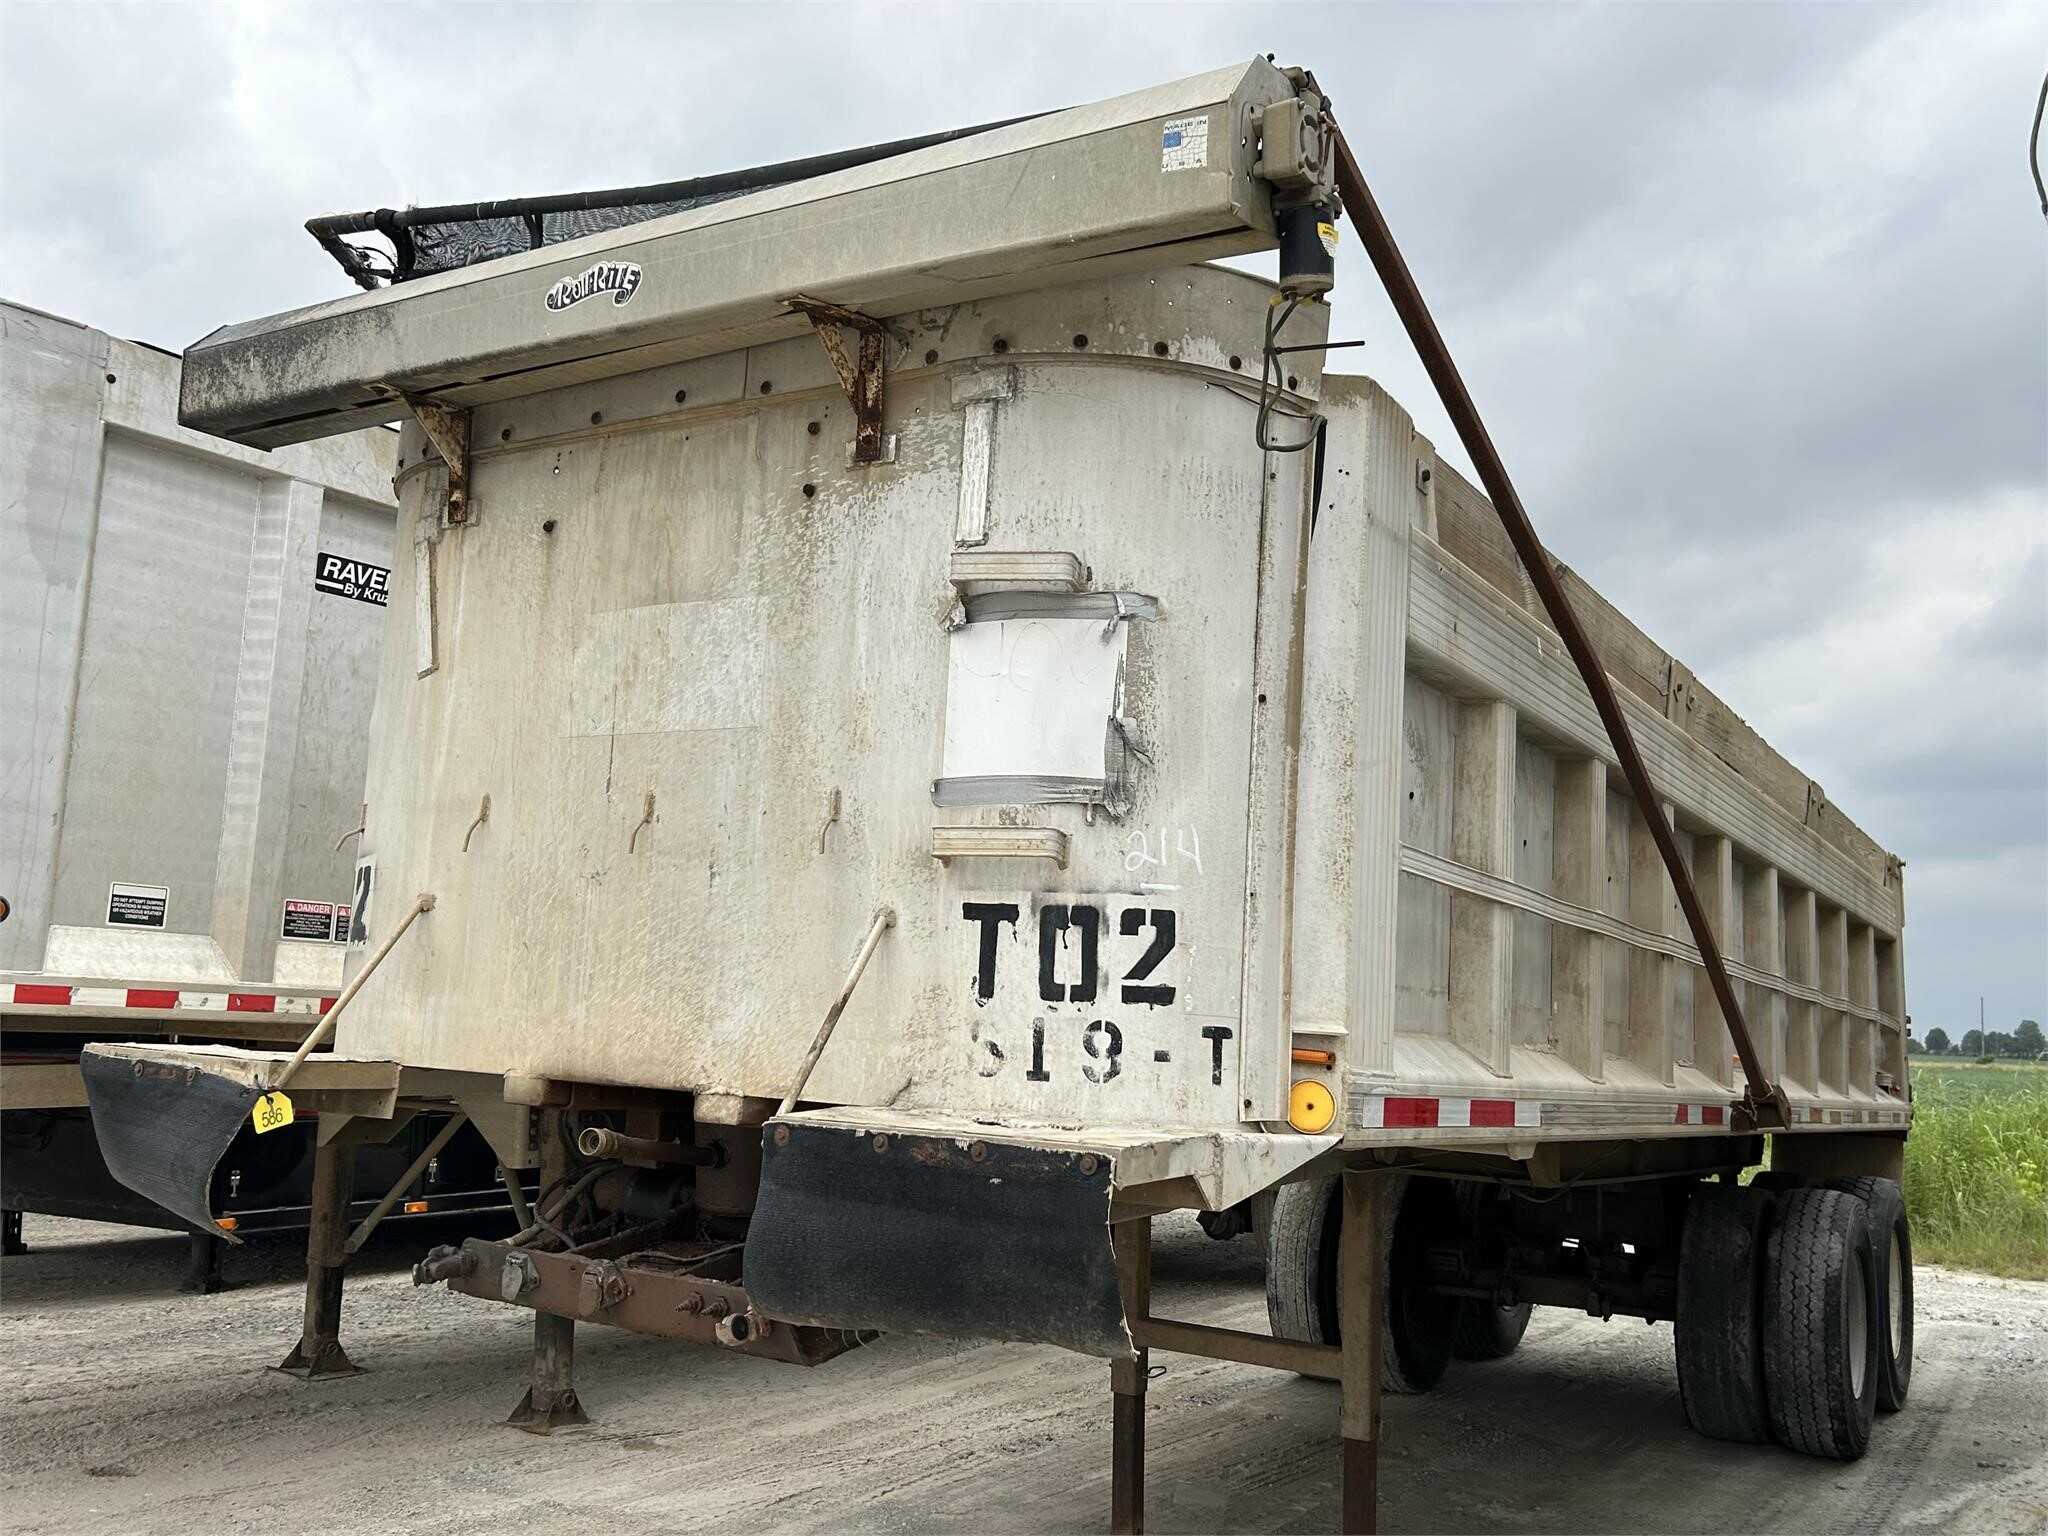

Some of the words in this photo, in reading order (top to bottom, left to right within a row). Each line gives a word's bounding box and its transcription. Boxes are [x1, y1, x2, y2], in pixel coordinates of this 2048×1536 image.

[343, 582, 361, 598] By
[1125, 824, 1203, 875] 214
[297, 903, 330, 914] DANGER
[262, 1108, 283, 1128] 586
